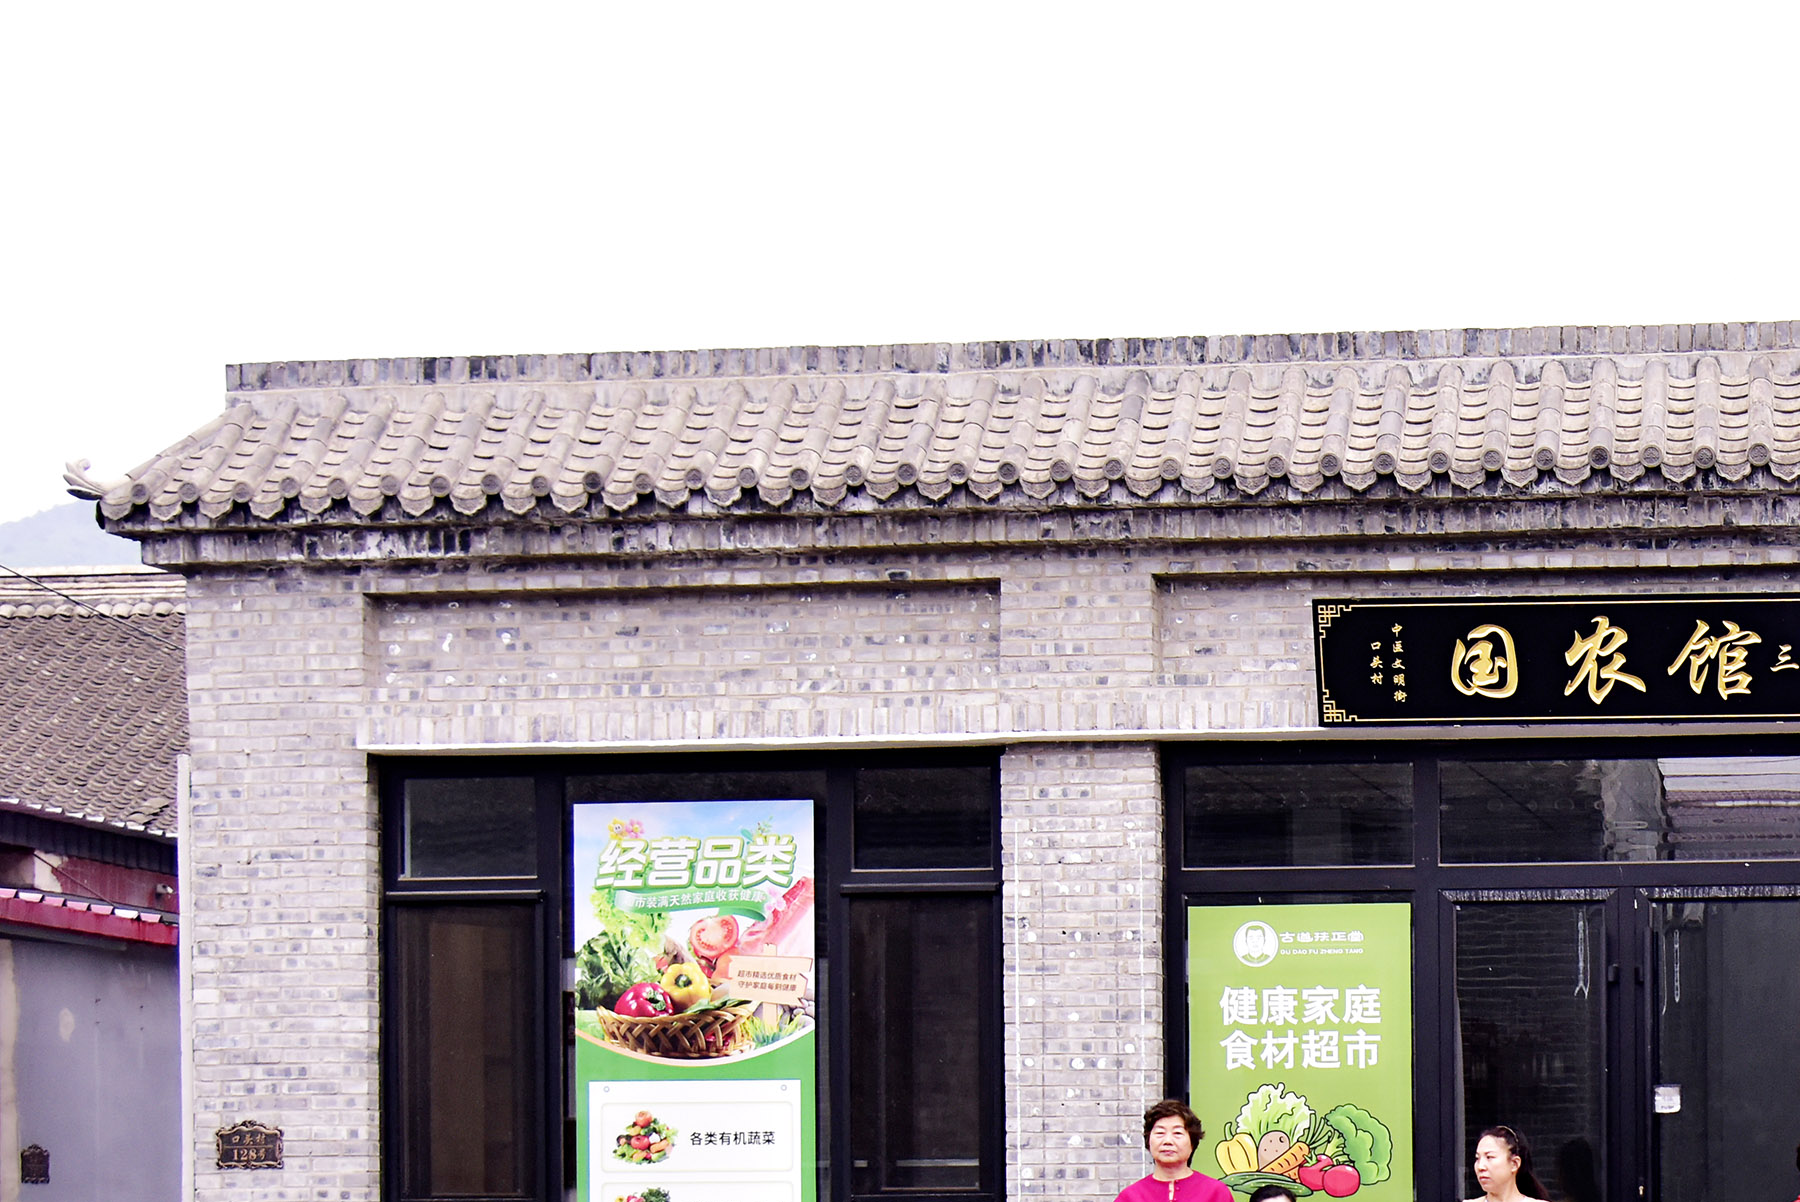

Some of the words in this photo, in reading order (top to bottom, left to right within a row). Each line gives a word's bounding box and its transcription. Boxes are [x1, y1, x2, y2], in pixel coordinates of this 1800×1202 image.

[1369, 640, 1384, 686] 口头村
[1450, 615, 1762, 705] 国农馆
[595, 835, 797, 889] 经营品类
[630, 888, 764, 909] 市装满天然家庭收获健康
[1219, 983, 1382, 1026] 健康家庭
[1219, 1028, 1382, 1071] 食材超市
[689, 1131, 776, 1146] 各类有机蔬菜
